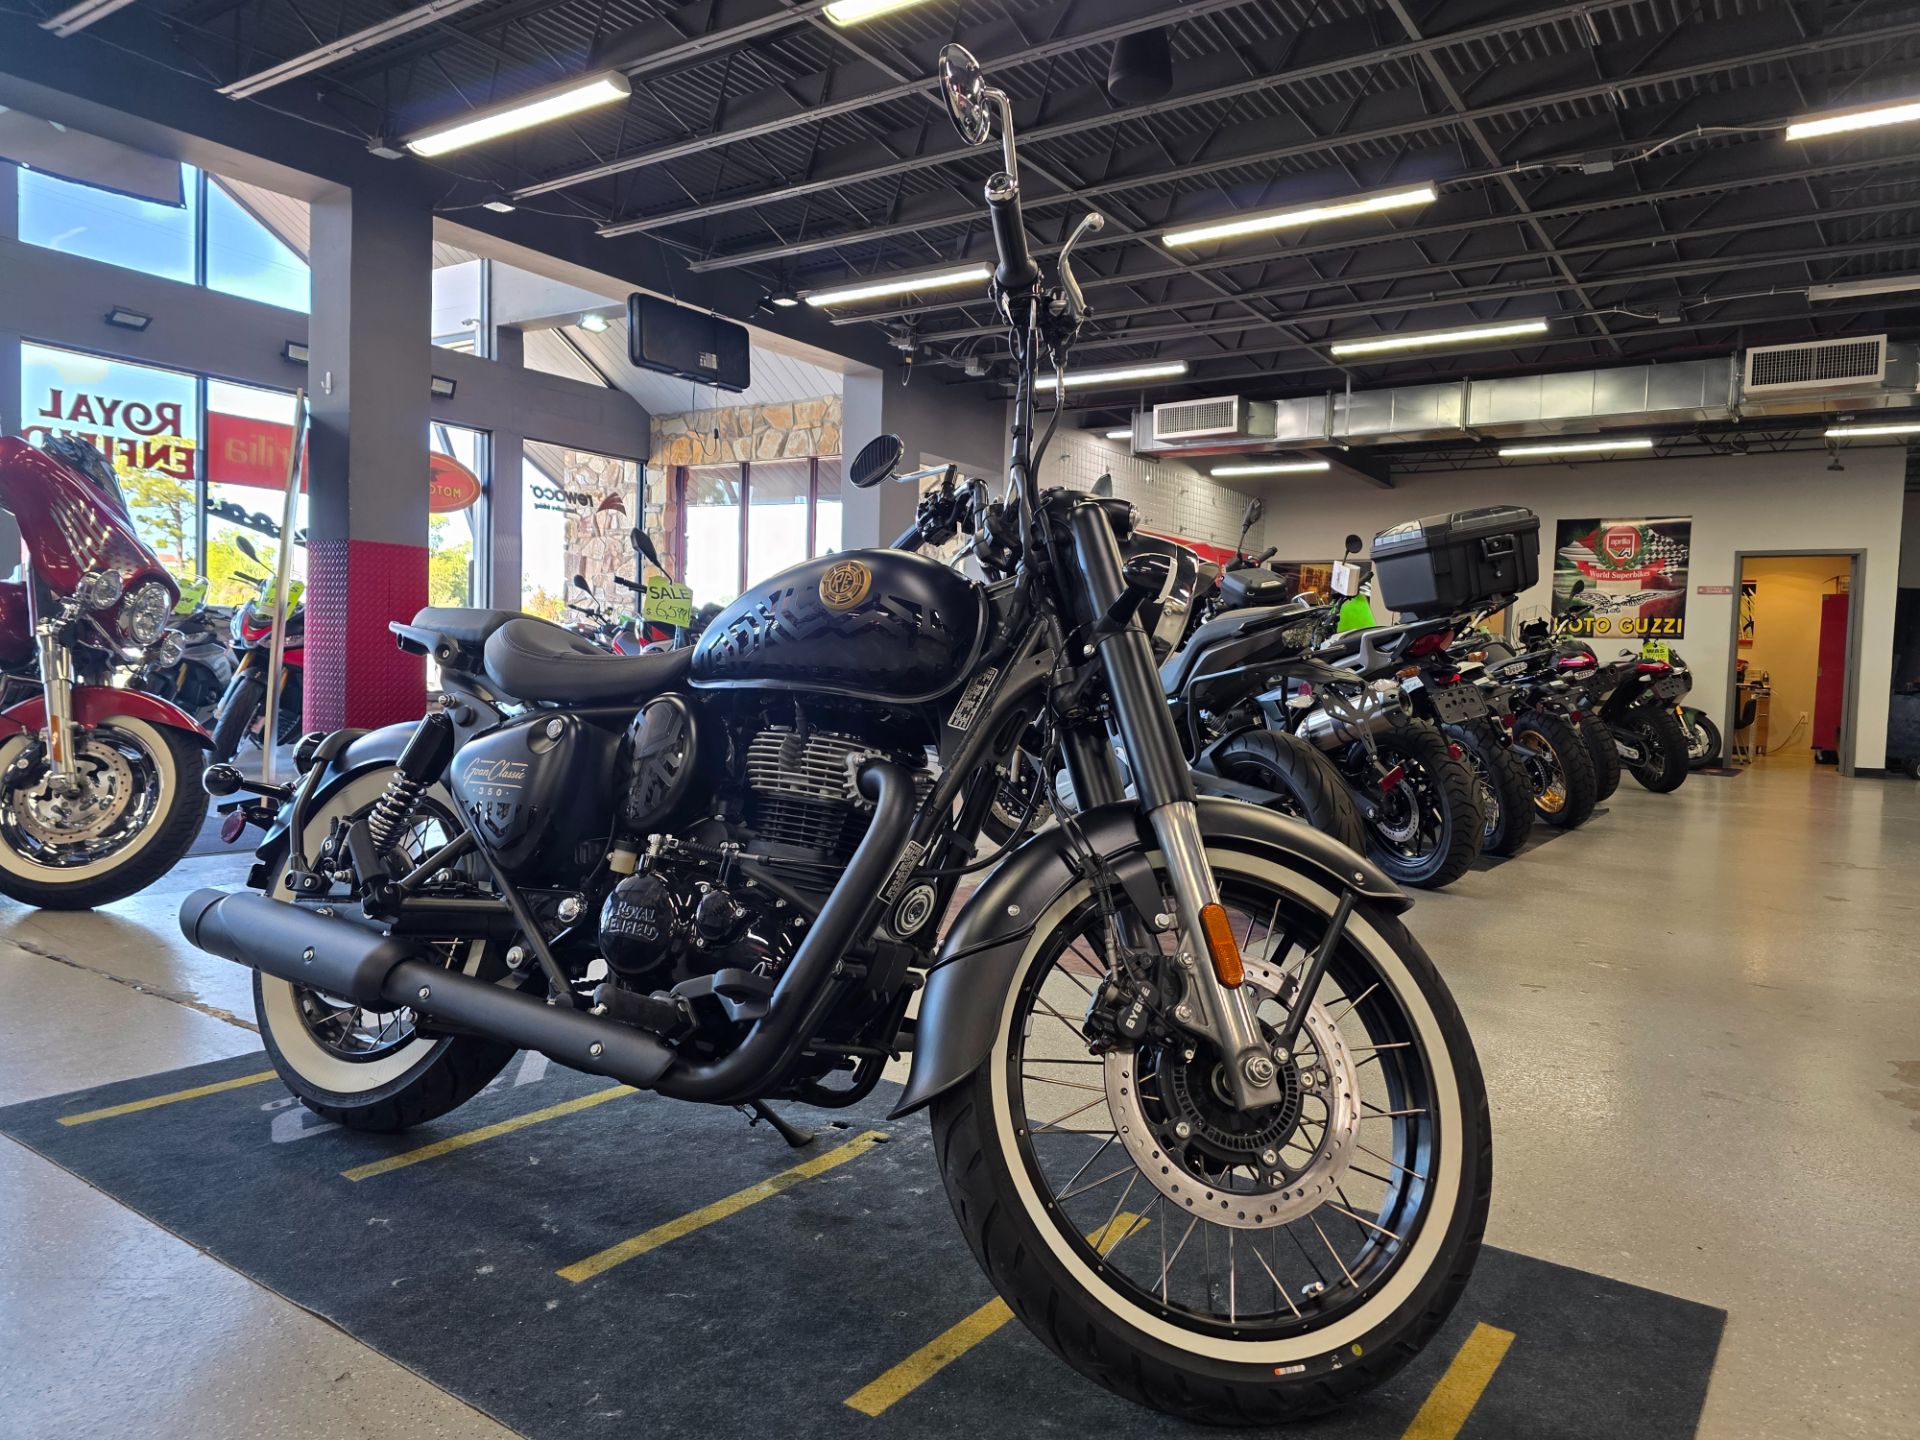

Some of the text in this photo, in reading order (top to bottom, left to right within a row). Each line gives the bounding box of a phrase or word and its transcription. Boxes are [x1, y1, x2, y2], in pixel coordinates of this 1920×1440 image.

[1610, 536, 1631, 546] aprilia
[1589, 569, 1651, 580] World Superbikes
[649, 586, 691, 600] SALE
[1618, 616, 1683, 635] GUZZI
[487, 760, 526, 781] Classic
[478, 787, 503, 797] 350
[614, 901, 656, 923] ROYAL
